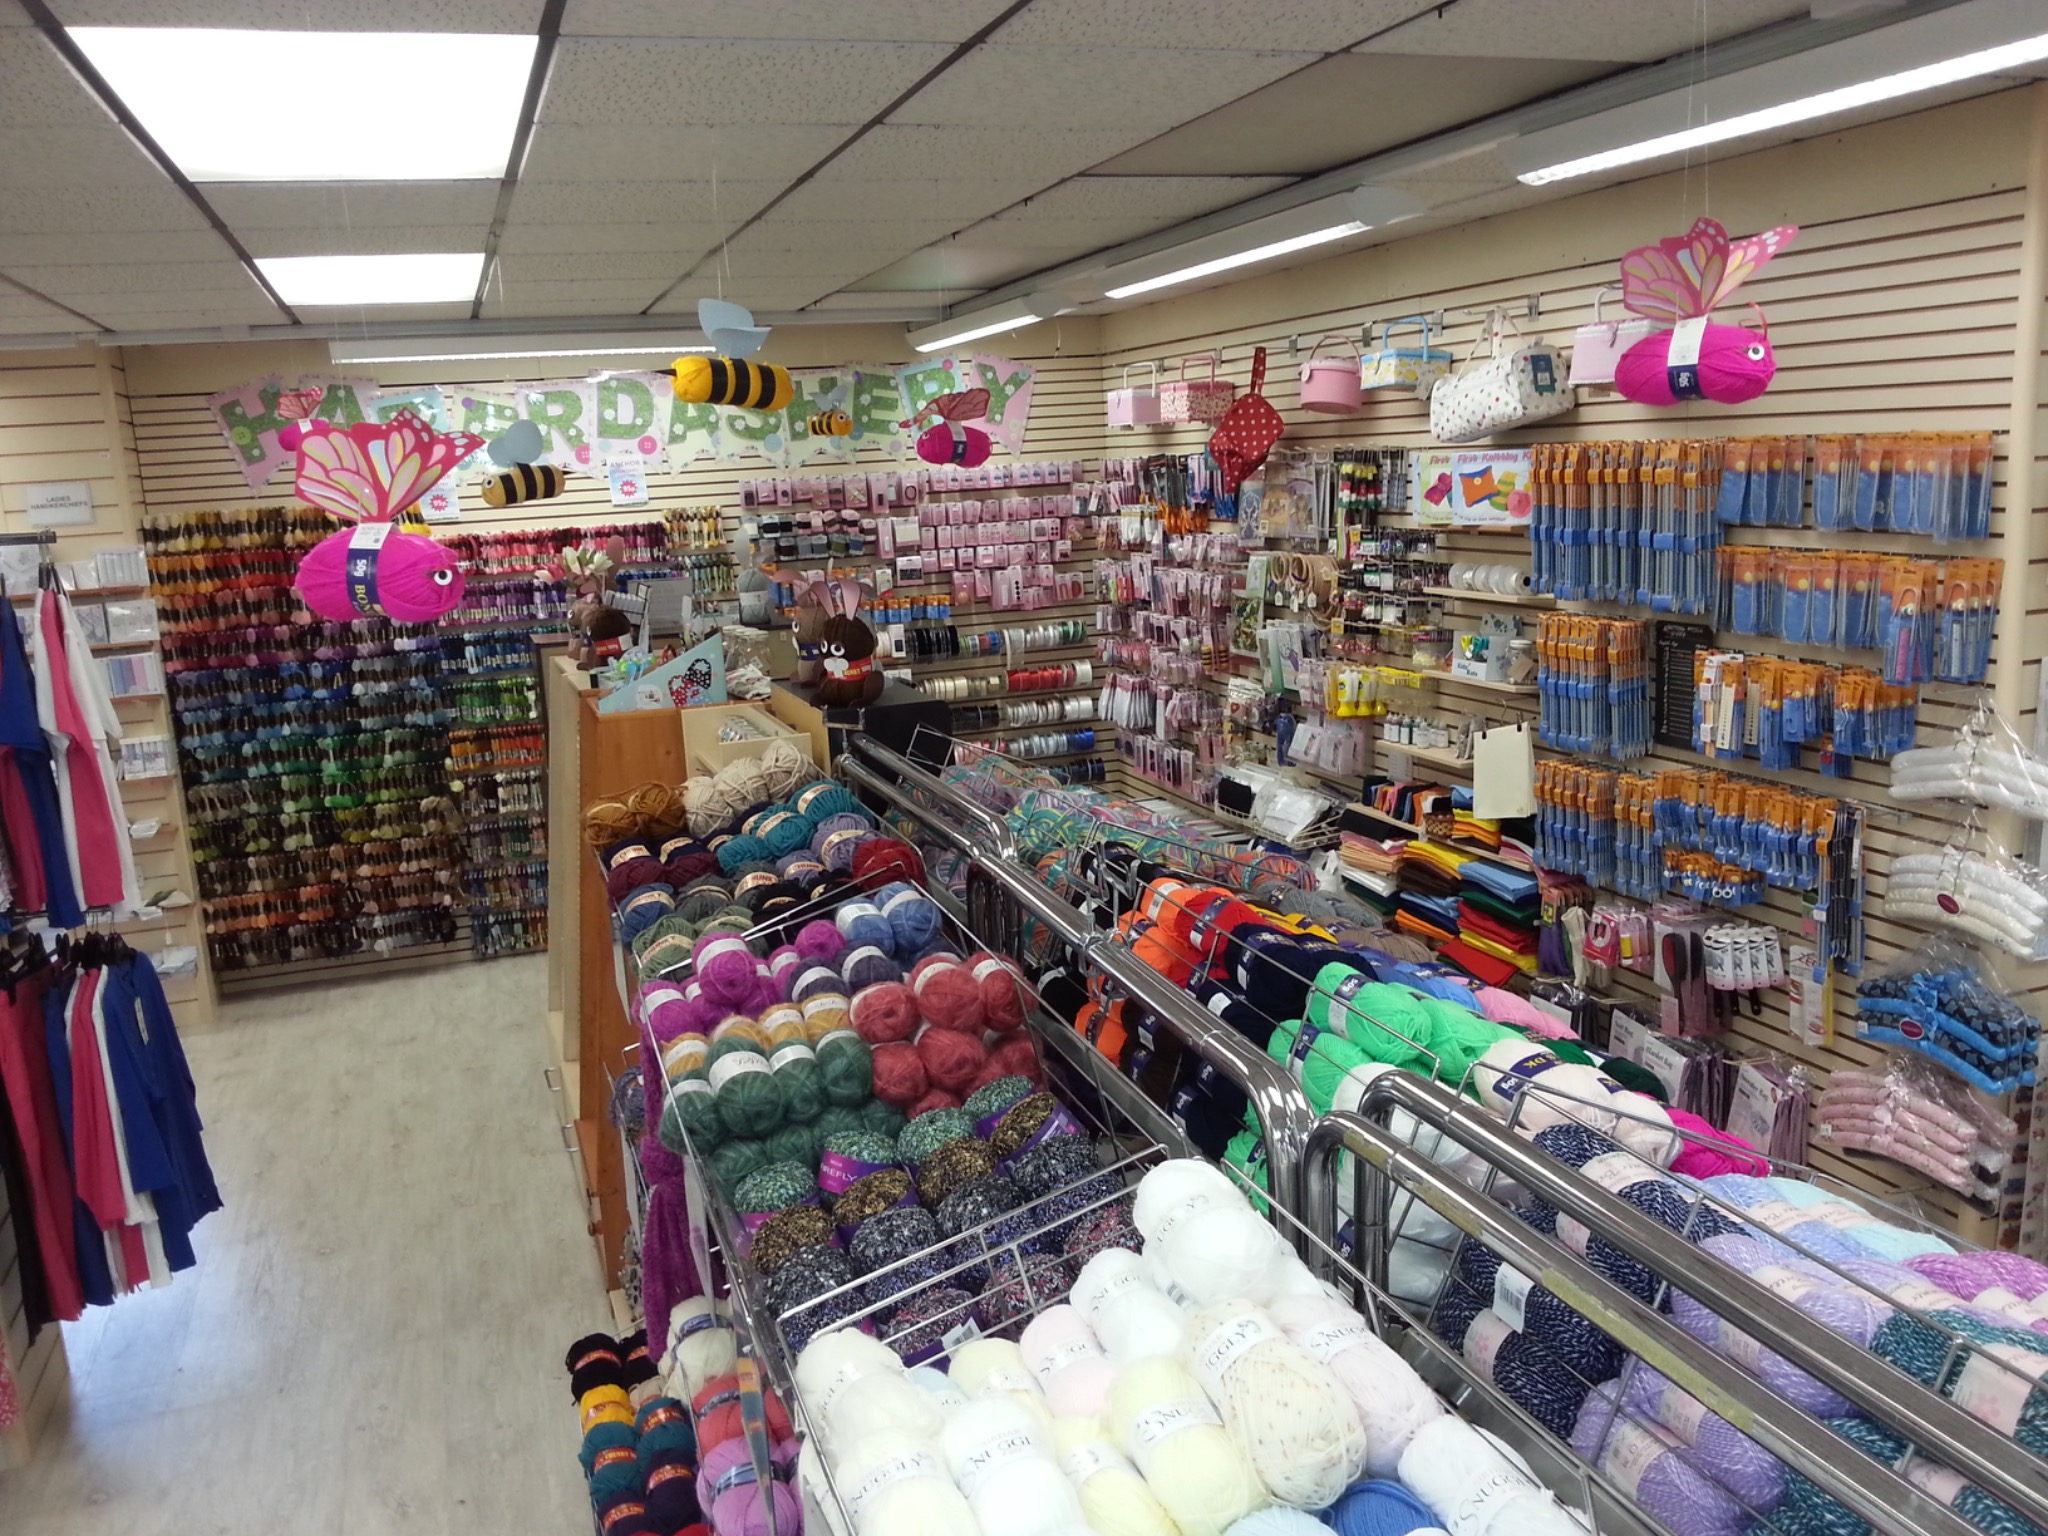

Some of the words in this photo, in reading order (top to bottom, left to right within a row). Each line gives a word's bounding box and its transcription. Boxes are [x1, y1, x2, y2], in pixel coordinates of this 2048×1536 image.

[1458, 454, 1478, 464] First
[1482, 452, 1518, 464] Knitting
[354, 559, 367, 577] 50g
[1342, 977, 1359, 992] 50g
